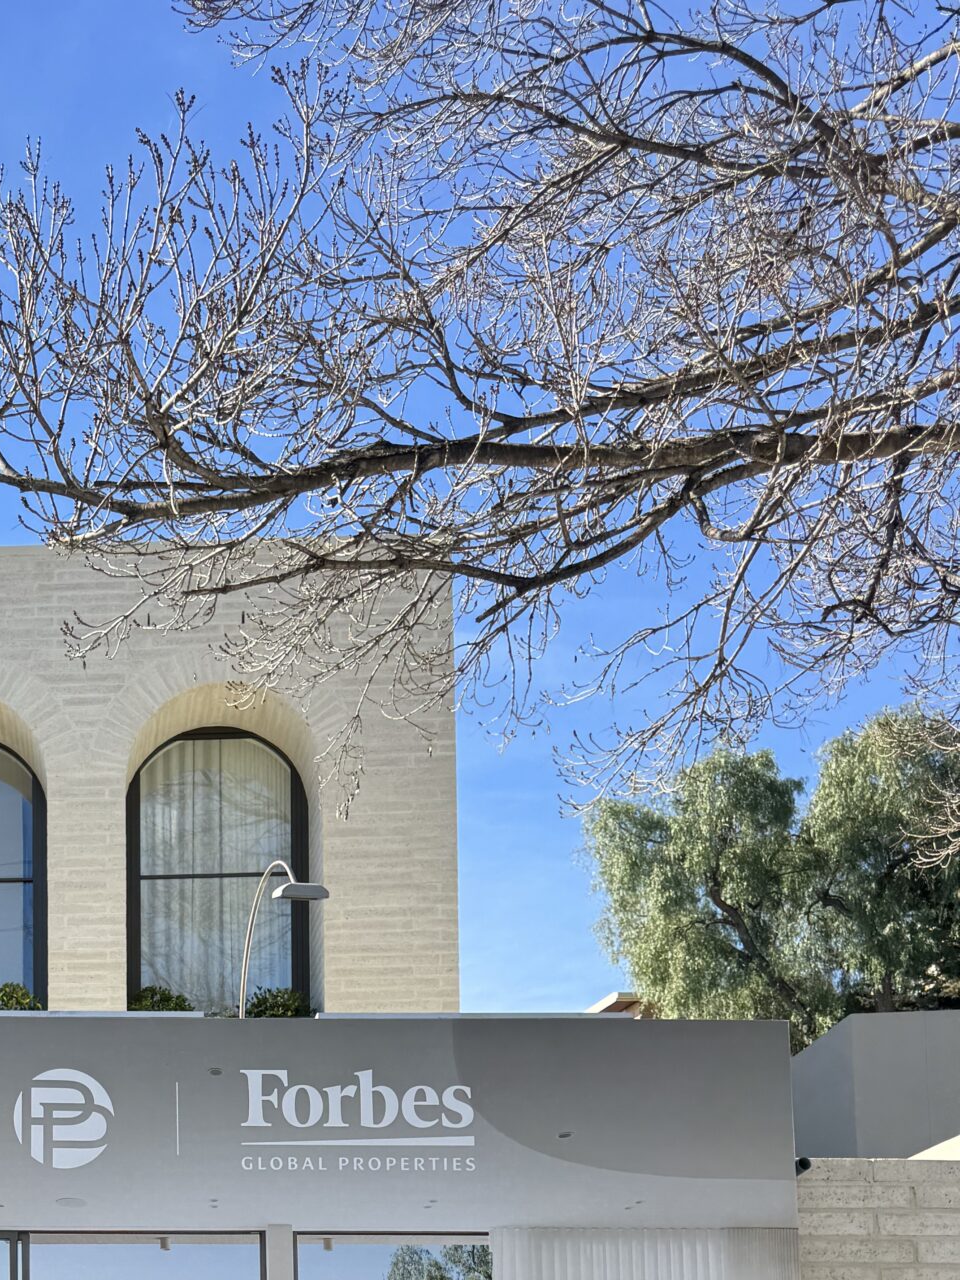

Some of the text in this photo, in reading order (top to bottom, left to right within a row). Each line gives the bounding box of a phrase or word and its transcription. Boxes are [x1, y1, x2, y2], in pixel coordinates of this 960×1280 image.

[239, 1069, 475, 1129] Forbes
[241, 1156, 476, 1171] GLOBAL PROPERTIES
